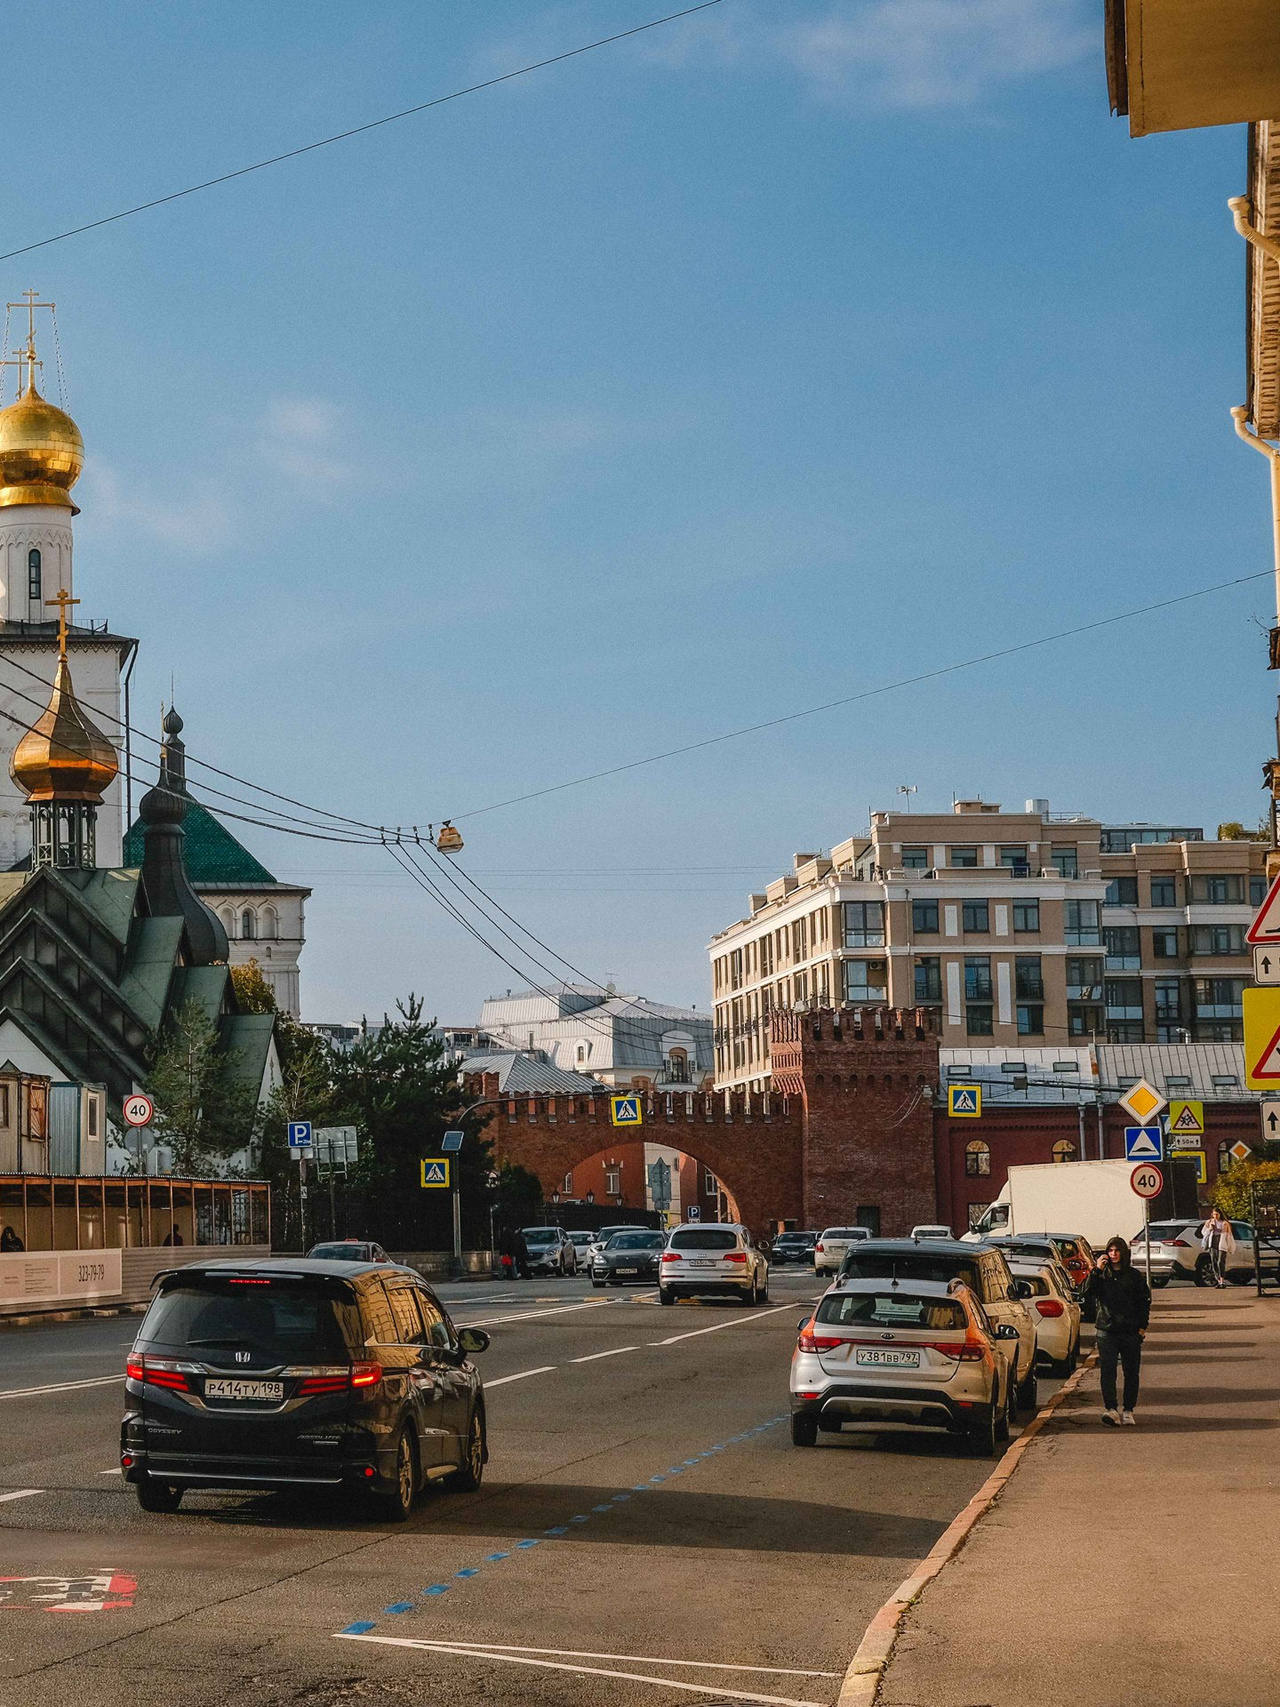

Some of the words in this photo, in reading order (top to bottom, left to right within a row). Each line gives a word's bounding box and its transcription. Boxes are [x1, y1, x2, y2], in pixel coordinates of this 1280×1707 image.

[130, 1105, 146, 1116] 40
[294, 1125, 307, 1145] P
[1137, 1174, 1156, 1188] 40
[691, 1207, 698, 1217] P
[79, 1264, 104, 1282] 323-79-79
[901, 1352, 916, 1361] 797
[261, 1383, 280, 1393] 198
